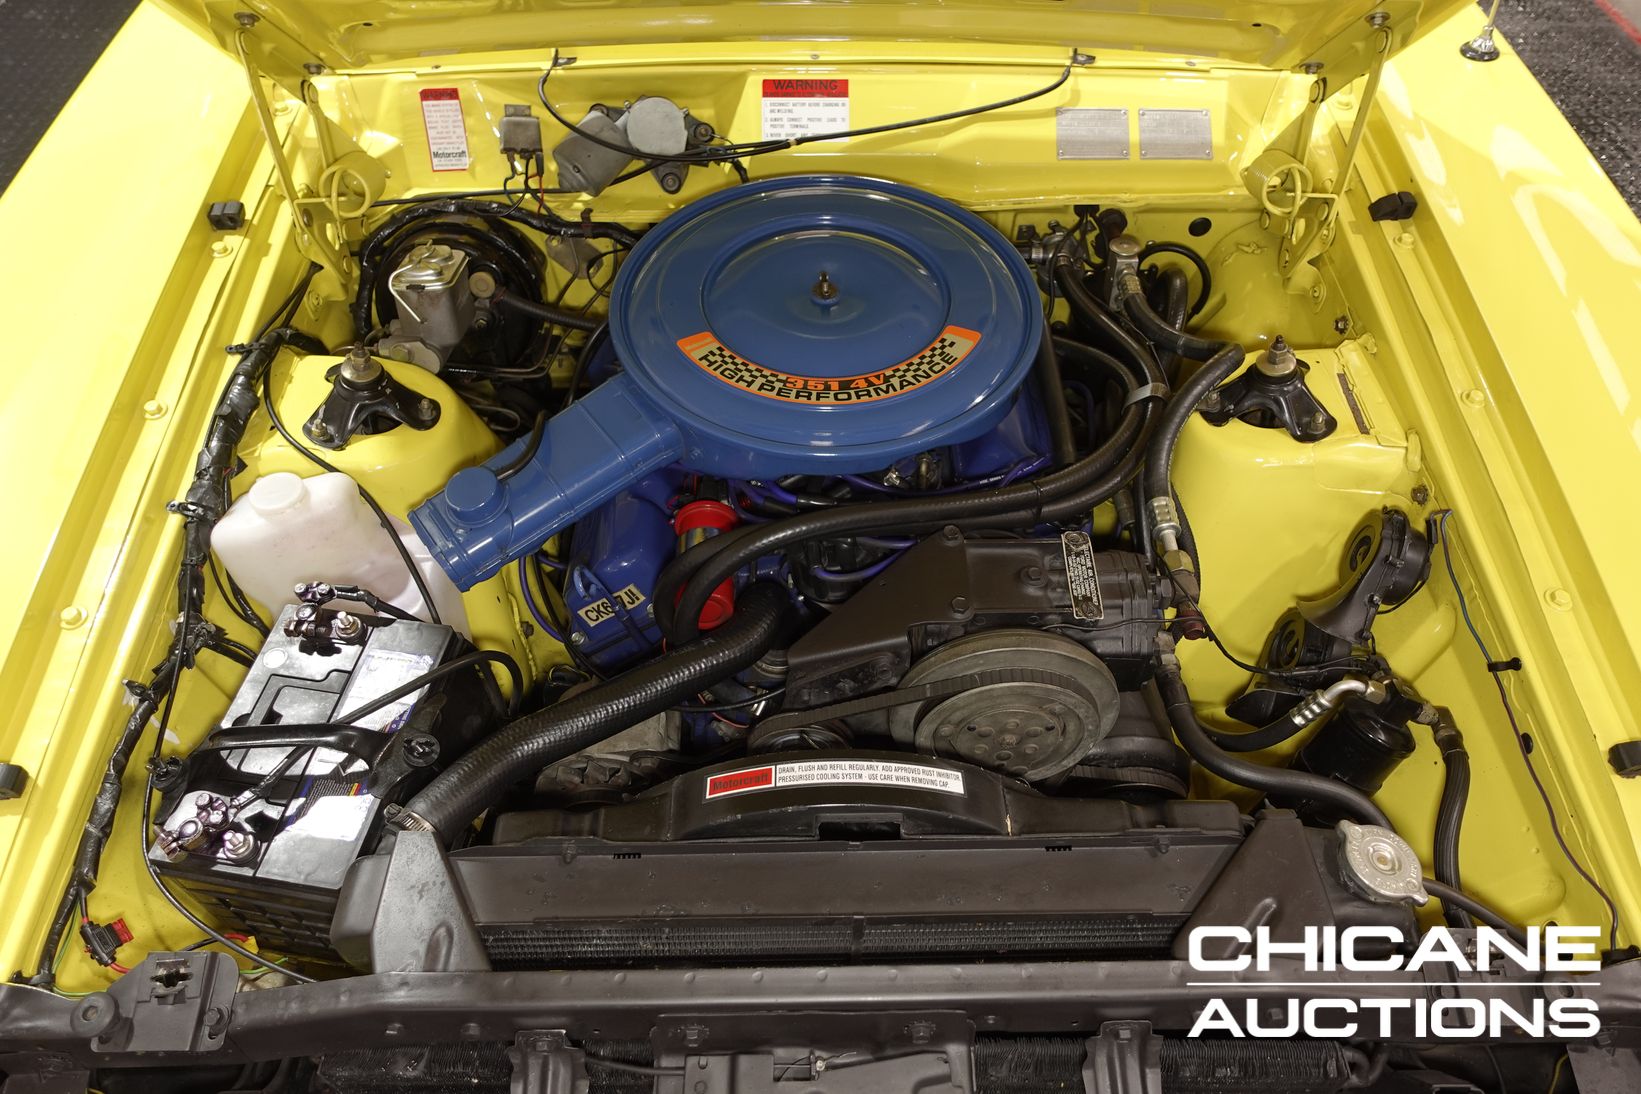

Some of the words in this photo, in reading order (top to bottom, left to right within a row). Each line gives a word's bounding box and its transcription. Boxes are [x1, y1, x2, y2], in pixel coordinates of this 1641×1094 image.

[773, 80, 838, 90] WARNING
[433, 151, 467, 159] Motorcraft
[698, 353, 756, 388] HIGH
[757, 353, 958, 401] PERFORMANCE
[786, 377, 840, 391] 351
[850, 373, 885, 388] 4V
[894, 766, 921, 775] APPROVED
[714, 774, 768, 790] Motorcraft
[779, 774, 815, 783] PRESSURISED
[895, 775, 911, 783] WHEN
[911, 777, 938, 787] REMOVING
